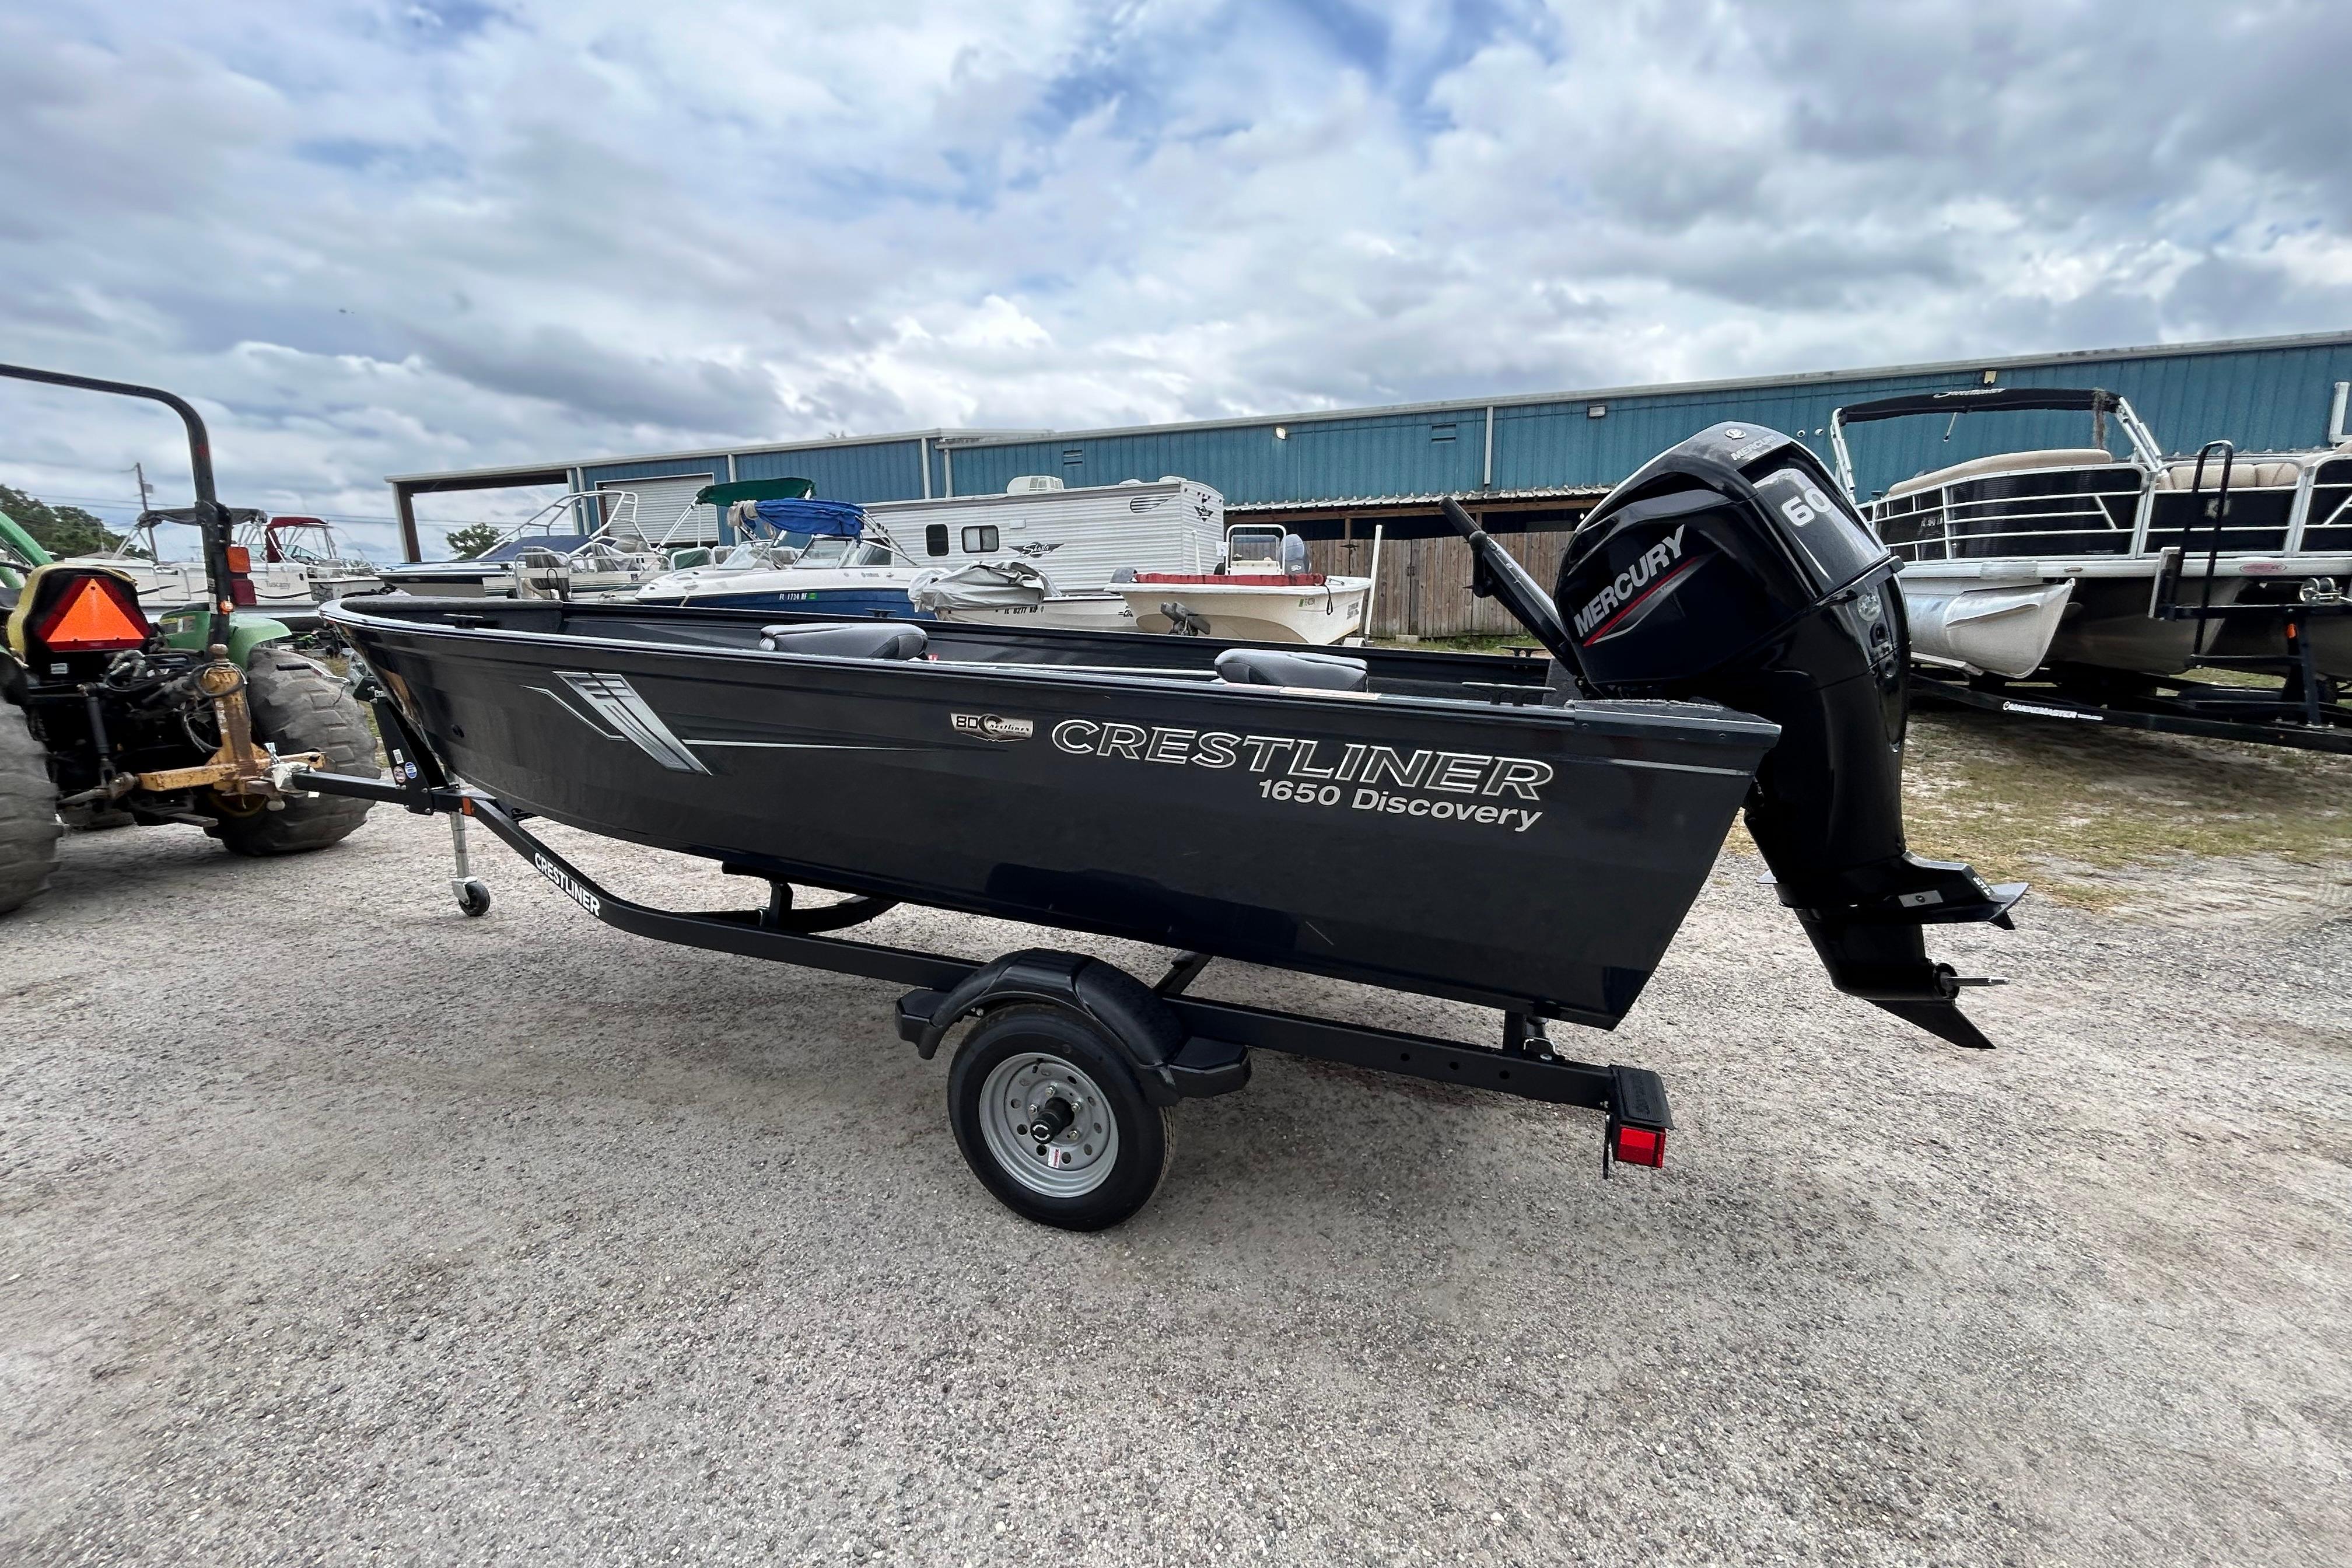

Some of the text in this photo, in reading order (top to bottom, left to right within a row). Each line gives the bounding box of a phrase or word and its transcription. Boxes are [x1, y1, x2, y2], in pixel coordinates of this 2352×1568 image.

[1731, 434, 1777, 461] MERCURY
[1782, 487, 1832, 527] 60
[1573, 524, 1685, 638] MERCURY
[957, 713, 1030, 735] 80 Crestliner
[1052, 719, 1553, 801] CRESTLINER
[1258, 779, 1543, 832] 1650 Discovery
[534, 852, 600, 916] CRESTLINER
